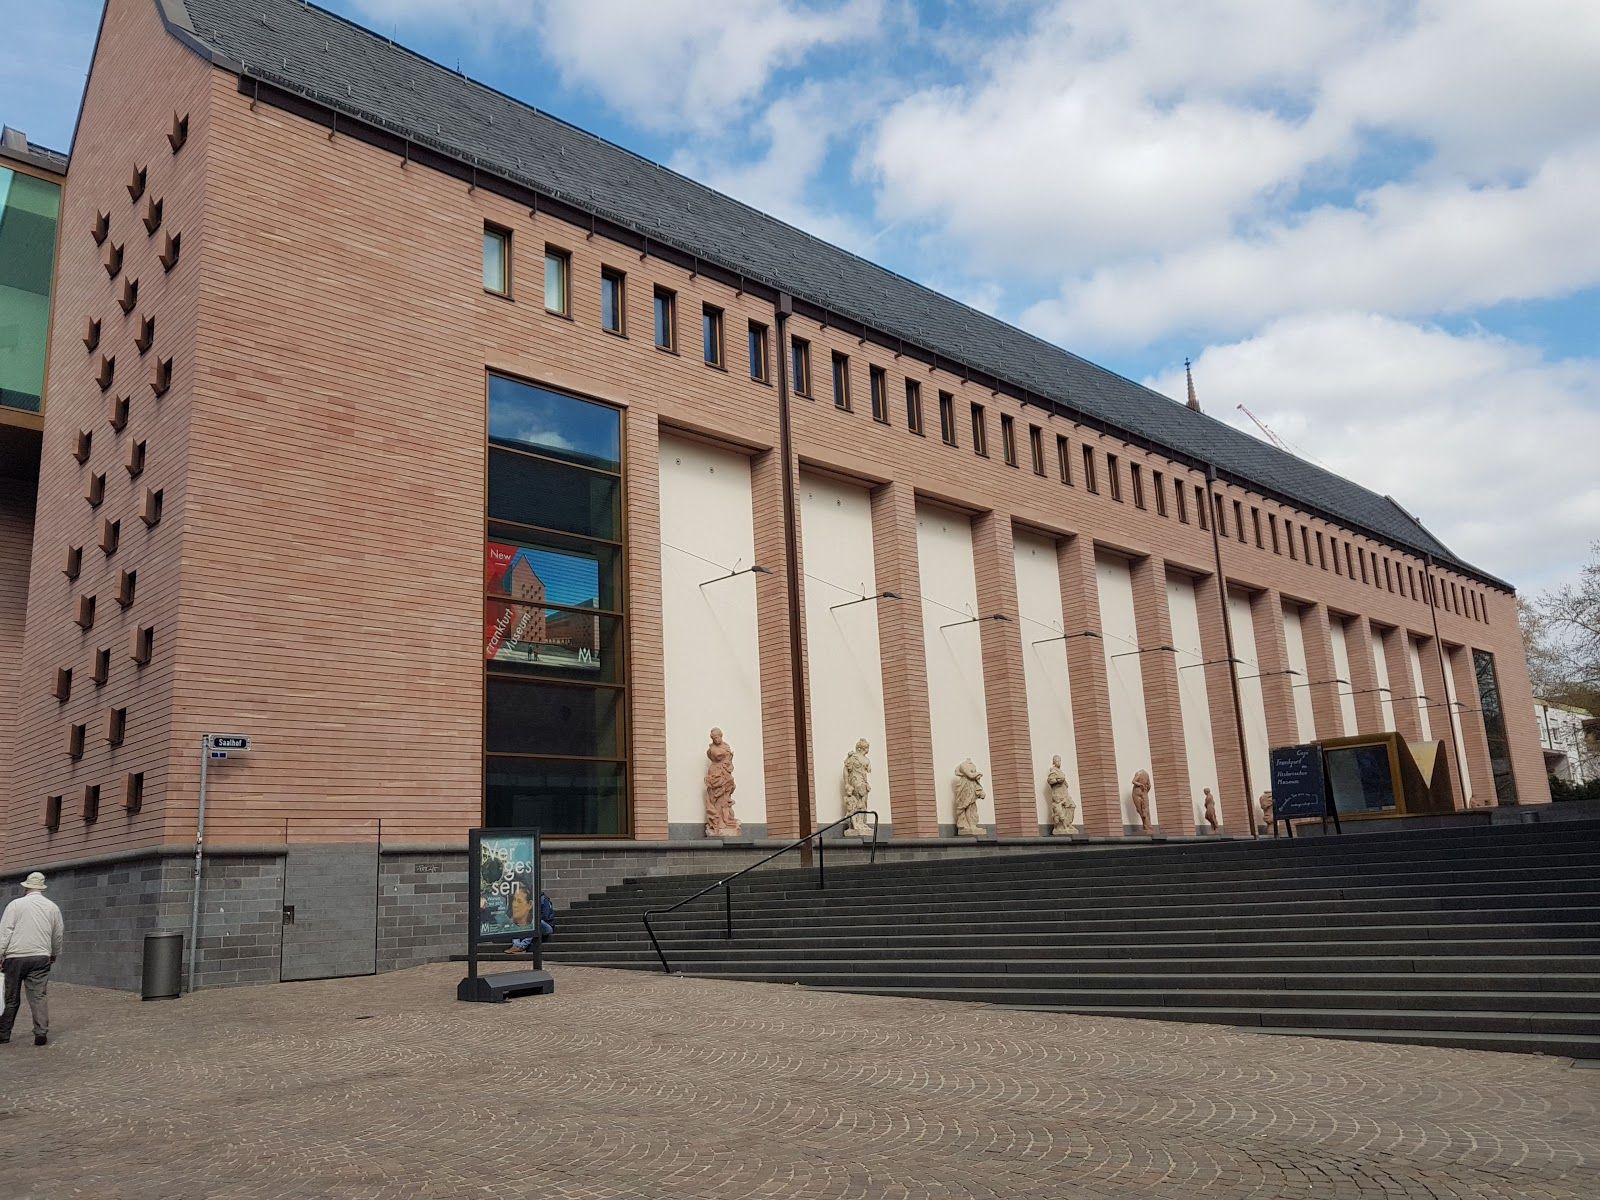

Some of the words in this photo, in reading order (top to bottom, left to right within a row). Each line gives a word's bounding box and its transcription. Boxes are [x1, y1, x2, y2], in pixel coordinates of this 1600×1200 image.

[490, 548, 512, 560] New
[503, 613, 532, 655] Museum
[218, 738, 242, 747] Saalhof
[485, 840, 516, 862] Ver
[503, 860, 532, 881] ges
[491, 881, 520, 896] sen
